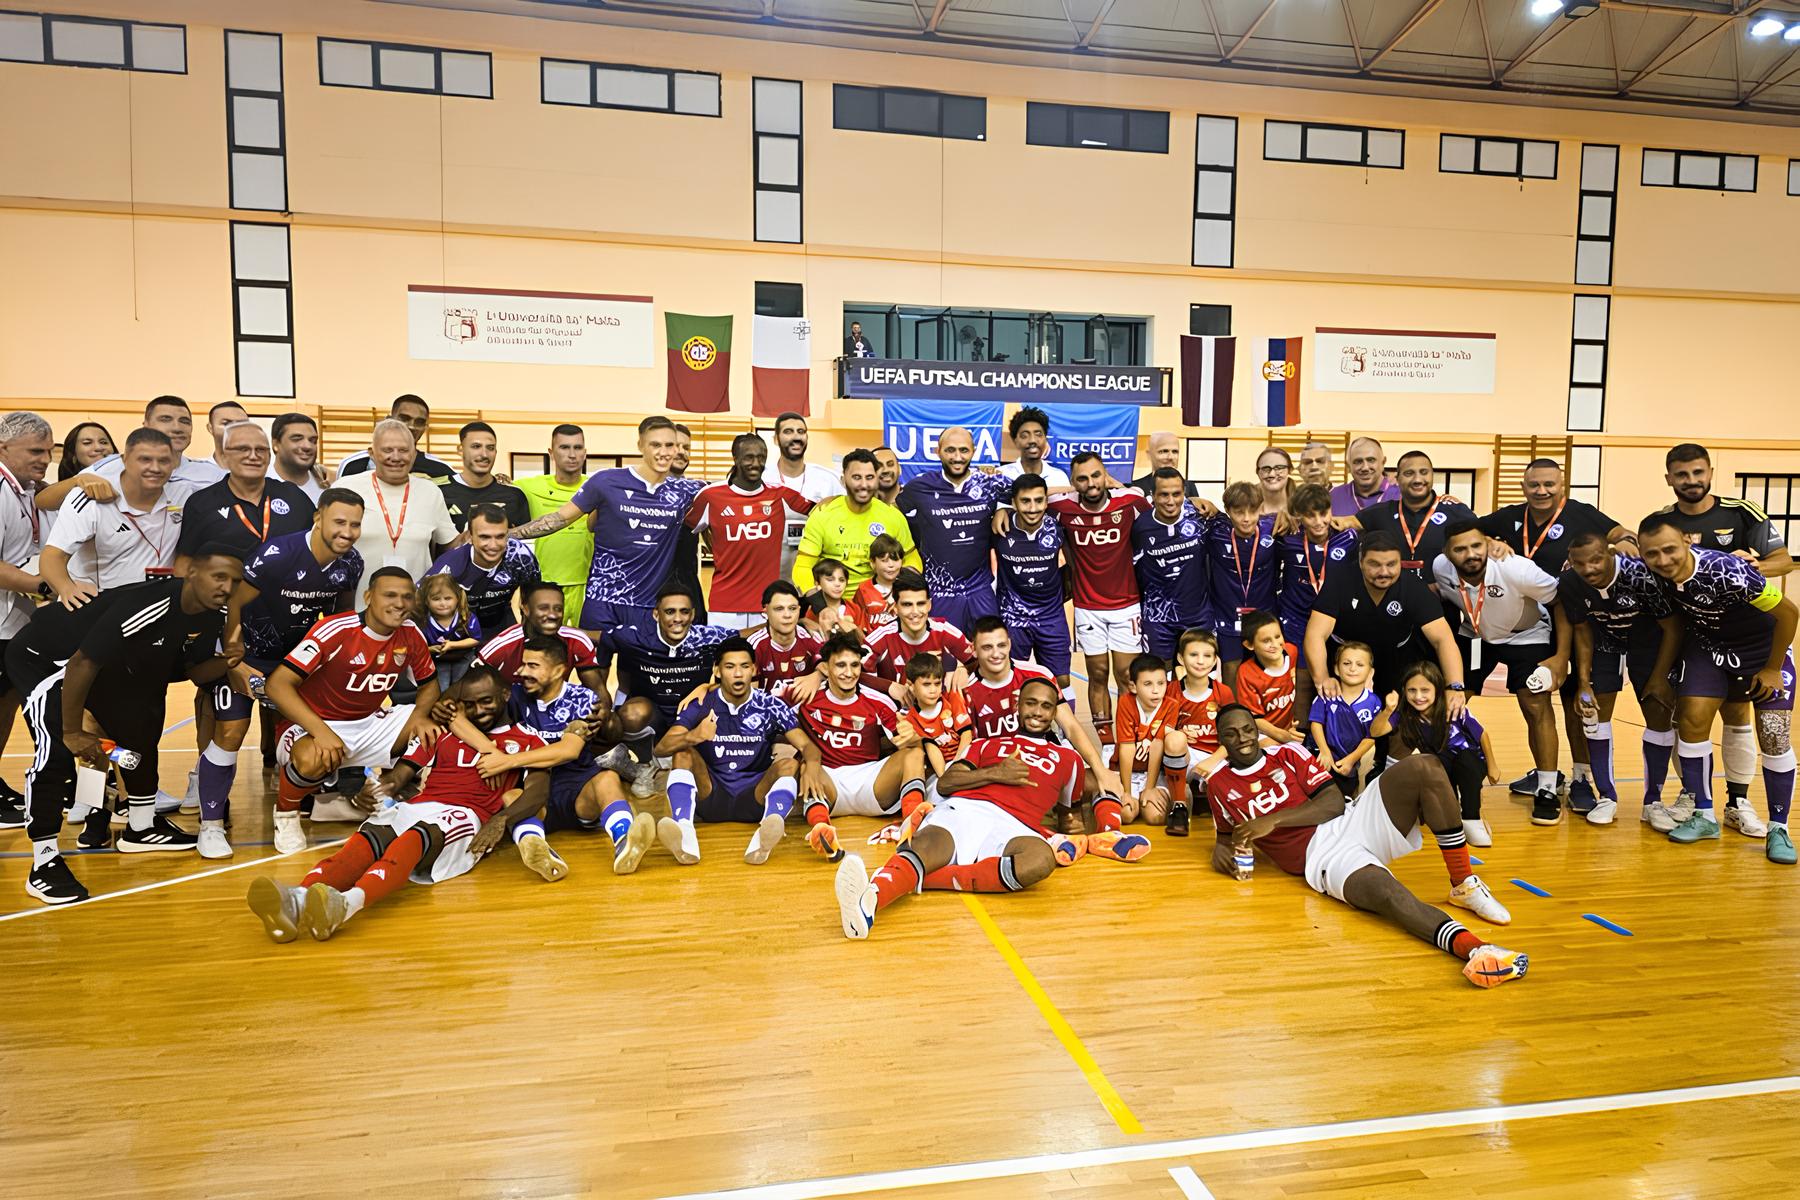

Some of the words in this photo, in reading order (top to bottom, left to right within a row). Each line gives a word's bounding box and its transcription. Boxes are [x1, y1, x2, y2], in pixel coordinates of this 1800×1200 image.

[860, 367, 907, 385] UEFA
[908, 369, 979, 387] FUTSAL
[980, 371, 1083, 390] CHAMPIONS
[1085, 374, 1151, 392] LEAGUE
[888, 425, 1000, 462] UEA
[1056, 441, 1133, 460] RESPECT
[725, 521, 772, 542] LASO
[1074, 528, 1120, 546] LASO
[345, 672, 399, 693] LASO
[985, 711, 1020, 738] LAS
[817, 729, 863, 749] ASO
